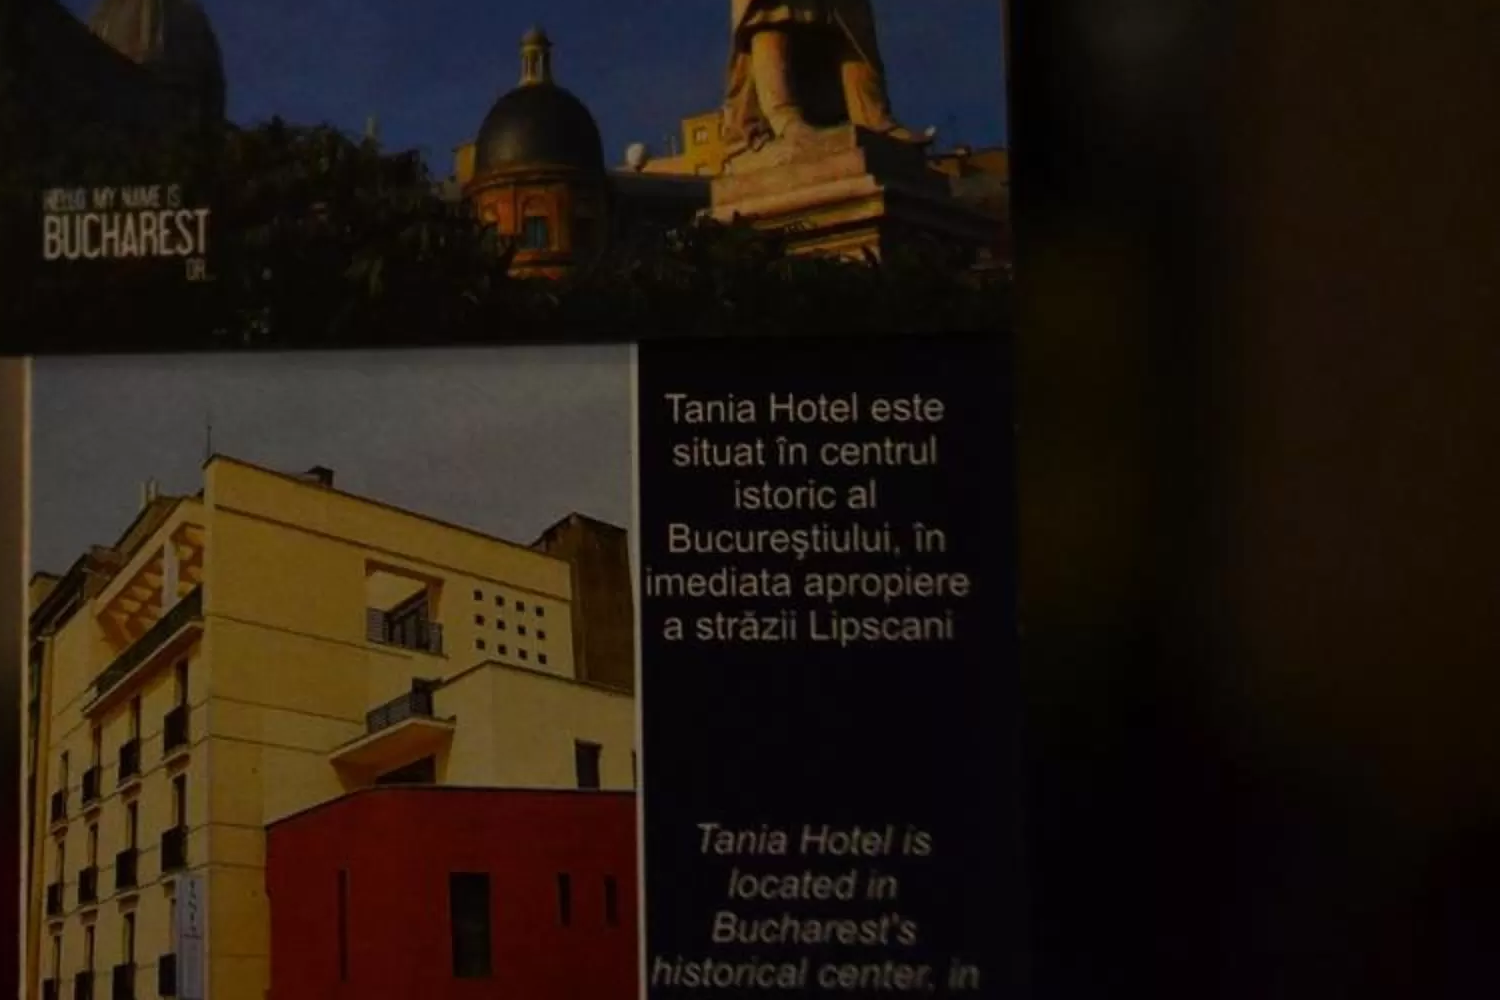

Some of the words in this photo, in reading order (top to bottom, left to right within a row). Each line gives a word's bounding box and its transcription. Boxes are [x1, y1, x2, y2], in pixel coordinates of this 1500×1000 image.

[43, 207, 210, 261] BUCHAREST
[664, 392, 756, 424] Tania
[768, 391, 859, 424] Hotel
[870, 392, 946, 423] este
[671, 437, 766, 468] situat
[776, 435, 808, 467] în
[819, 434, 938, 467] centrul
[733, 478, 837, 511] istoric
[845, 478, 878, 511] al
[667, 521, 902, 561] Bucureştiului,
[911, 520, 947, 553] în
[645, 565, 793, 598] imediata
[803, 565, 972, 605] apropiere
[663, 617, 684, 642] a
[695, 609, 798, 642] străzii
[809, 608, 955, 648] Lipscani
[696, 821, 789, 856] Tania
[799, 823, 896, 856] Hotel
[902, 822, 933, 856] is
[727, 866, 857, 901] located
[866, 867, 899, 901] in
[710, 909, 918, 946] Bucharest's
[651, 954, 811, 990] historical
[816, 957, 936, 993] center,
[947, 957, 981, 990] in
